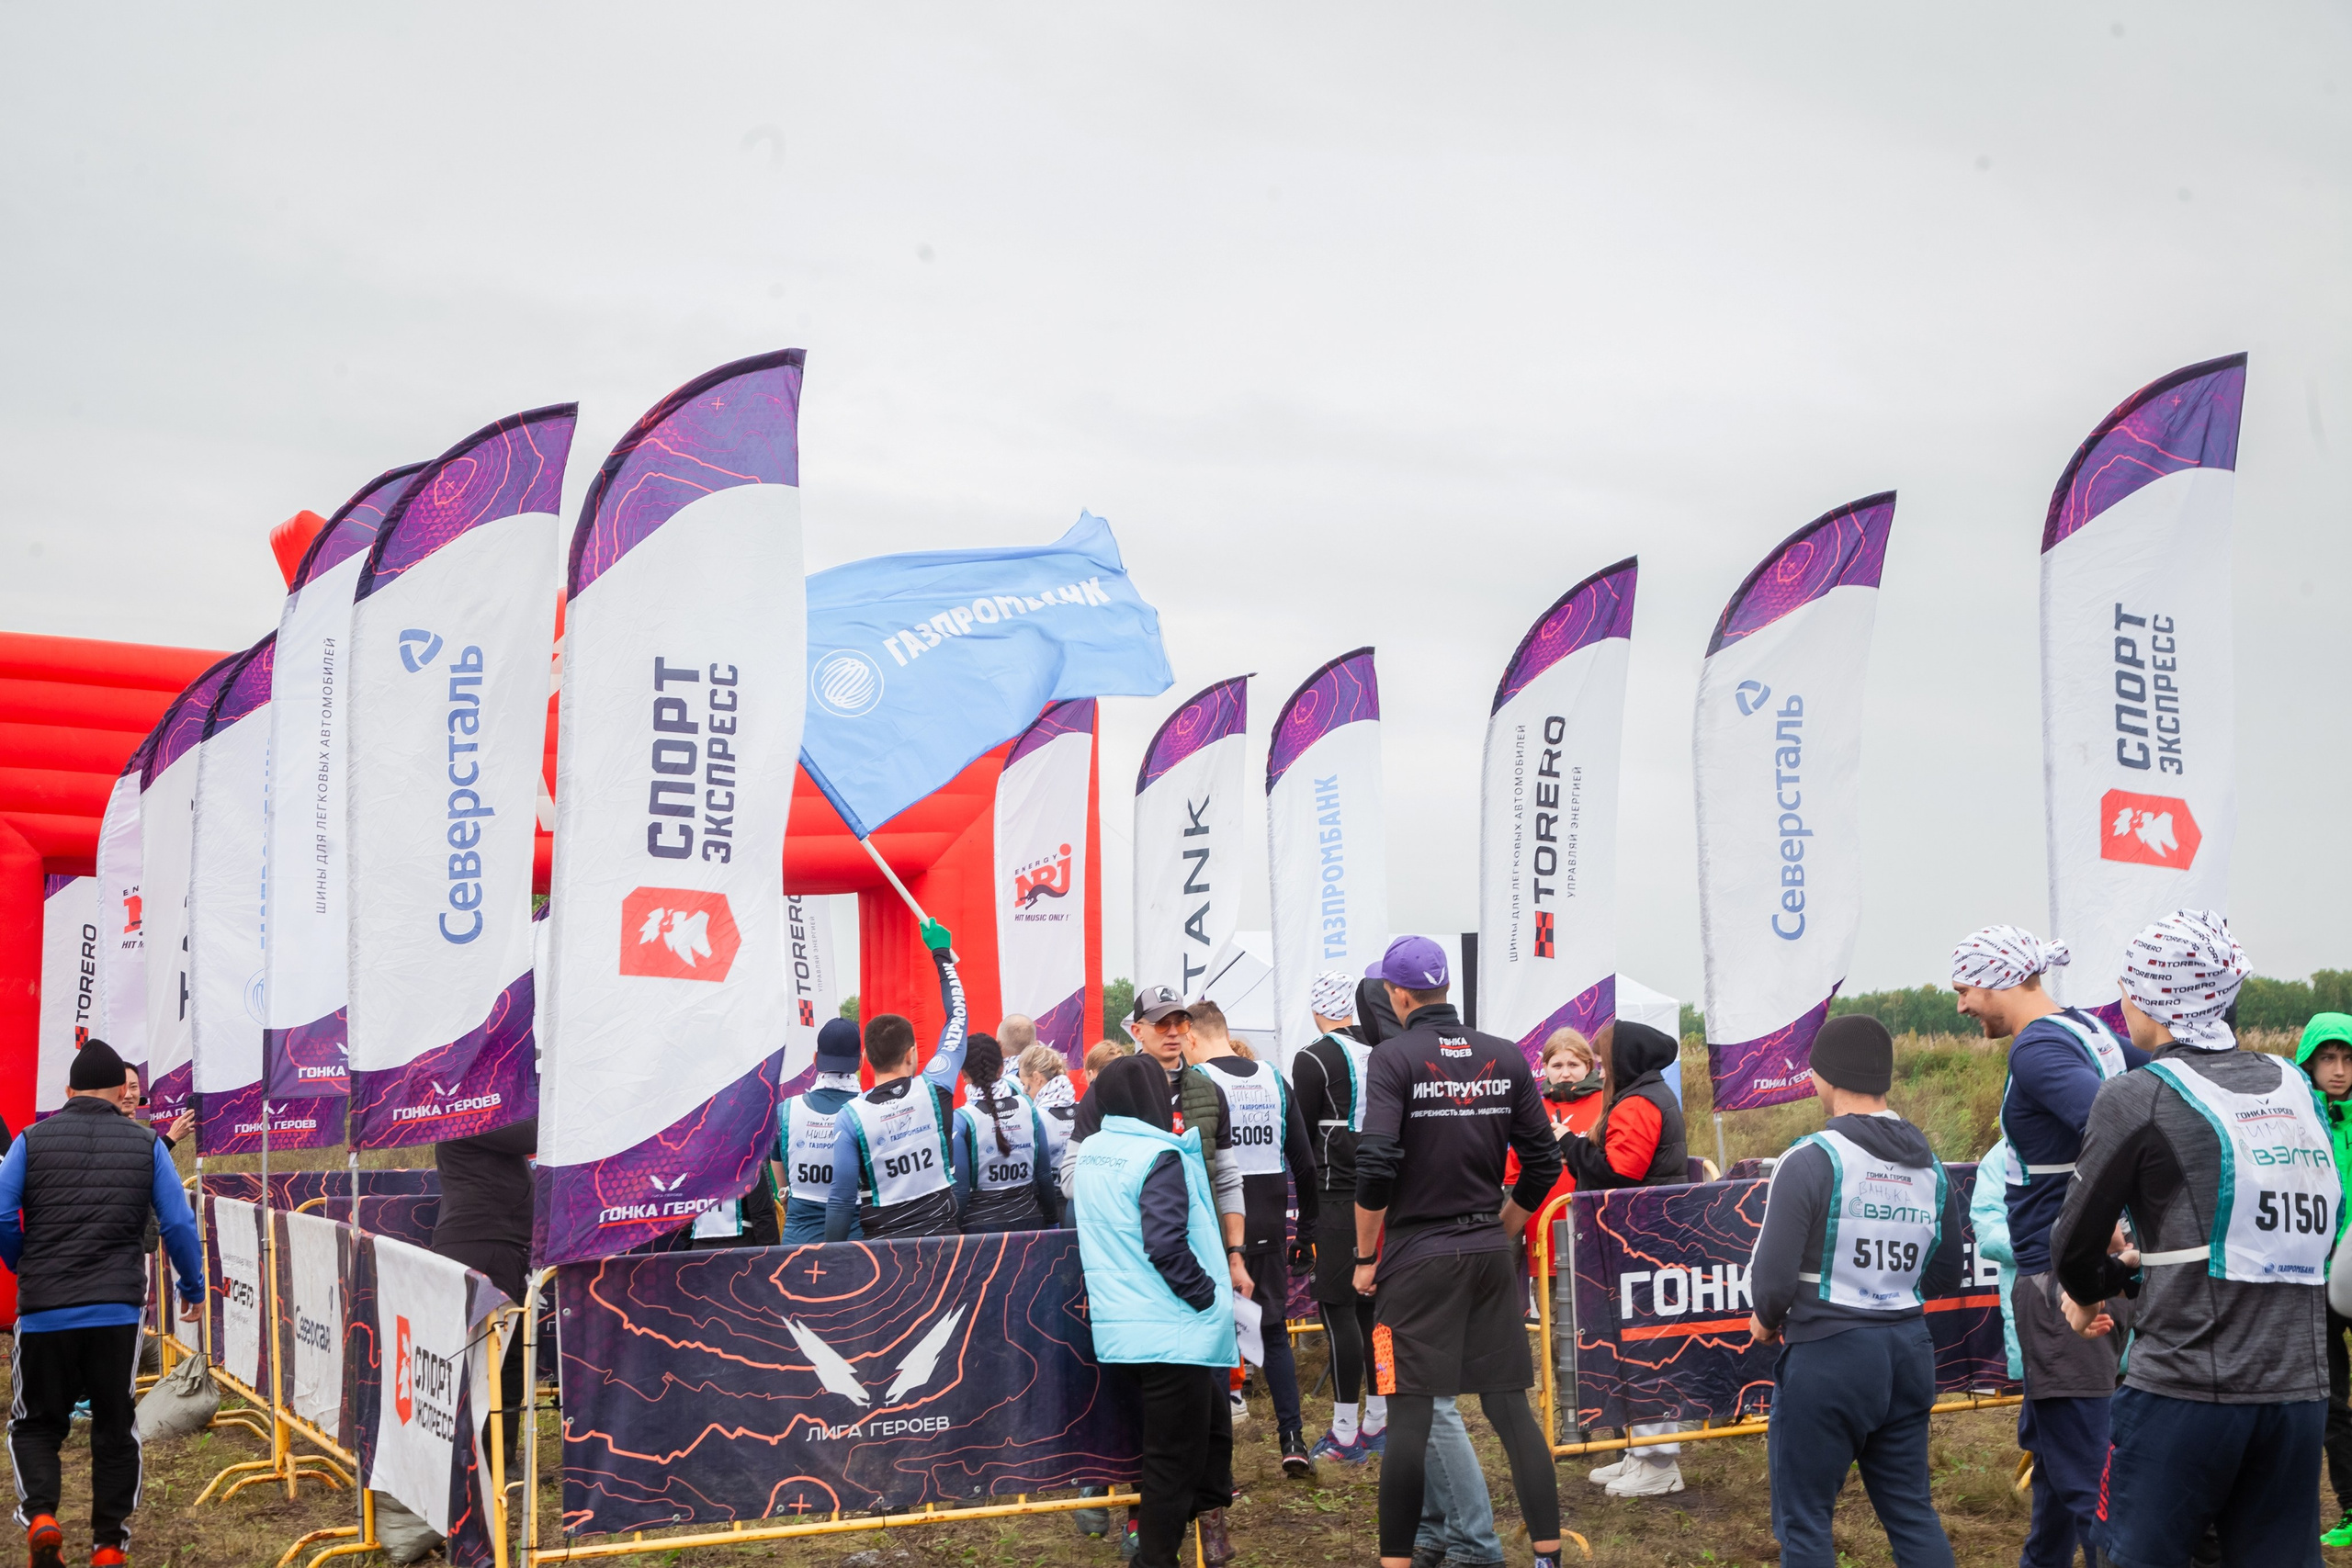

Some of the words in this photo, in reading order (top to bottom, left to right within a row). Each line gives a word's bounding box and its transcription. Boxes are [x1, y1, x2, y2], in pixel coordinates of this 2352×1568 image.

[319, 637, 336, 748] АВТОМОБИЛЕЙ
[2114, 602, 2152, 771] СПОРТ
[2152, 614, 2183, 775] ЭКСПРЕСС
[647, 656, 700, 860] СПОРТ
[701, 662, 739, 864] ЭКСПРЕСС
[1514, 724, 1526, 819] АВТОМОБИЛЕЙ
[316, 750, 331, 830] ЛЕГКОВЫХ
[438, 645, 496, 945] Северсталь
[1570, 766, 1583, 829] ЭНЕРГИЕЙ
[1533, 715, 1566, 904] TORERO
[1771, 694, 1815, 941] Северсталь
[316, 834, 329, 865] ДЛЯ
[1014, 853, 1058, 875] ENERGY
[1511, 823, 1523, 889] ЛЕГКОВЫХ
[1314, 773, 1348, 960] ГАЗПРОМБАНК
[1566, 834, 1577, 898] УПРАВЛЯЙ
[315, 868, 327, 915] ШИНЫ
[1182, 794, 1211, 997] TANK
[1511, 893, 1521, 919] ДЛЯ
[1014, 913, 1024, 921] HIT
[1024, 913, 1047, 921] MUSIC
[1048, 913, 1065, 921] ONLY
[1509, 922, 1519, 963] ШИНЫ
[75, 923, 97, 1023] TORERO
[2172, 981, 2216, 994] TORERO
[941, 962, 967, 1053] GAZPROMBANK
[2142, 998, 2181, 1007] TORERO
[2184, 1000, 2227, 1020] TORERO
[1438, 1037, 1468, 1046] ГОНКА
[1440, 1048, 1473, 1058] ГЕРОЕВ
[298, 1066, 346, 1078] ГОНКА
[1753, 1077, 1787, 1089] ГОНКА
[1788, 1066, 1814, 1087] ГЕРО
[1412, 1078, 1512, 1100] ИНСТРУКТОР
[149, 1107, 174, 1121] НКА
[392, 1105, 443, 1121] ГОНКА
[445, 1092, 502, 1114] ГЕРОЕВ
[2234, 1108, 2267, 1120] ГОНКА
[2267, 1107, 2295, 1117] ГЕРОЕВ
[274, 1119, 317, 1130] ГЕРОЕВ
[889, 1123, 933, 1143] ГАЗПРОМБАНК
[1231, 1125, 1273, 1146] 5009
[808, 1142, 834, 1150] ГАЗПРО
[797, 1163, 833, 1184] 500
[884, 1147, 934, 1179] 5012
[988, 1162, 1029, 1182] 5003
[1866, 1171, 1889, 1179] ГОНКА
[1890, 1173, 1912, 1183] ГЕРОЕВ
[1859, 1181, 1913, 1206] ВАНЬКА
[598, 1203, 658, 1224] ГОНКА
[2255, 1190, 2328, 1235] 5150
[1852, 1237, 1919, 1273] 5159
[2277, 1265, 2316, 1275] ГАЗПРОМБАНК
[1620, 1263, 1755, 1320] ГОНК
[414, 1346, 453, 1405] СПОРТ
[805, 1424, 863, 1442] ЛИГА
[870, 1416, 950, 1438] ГЕРОЕВ
